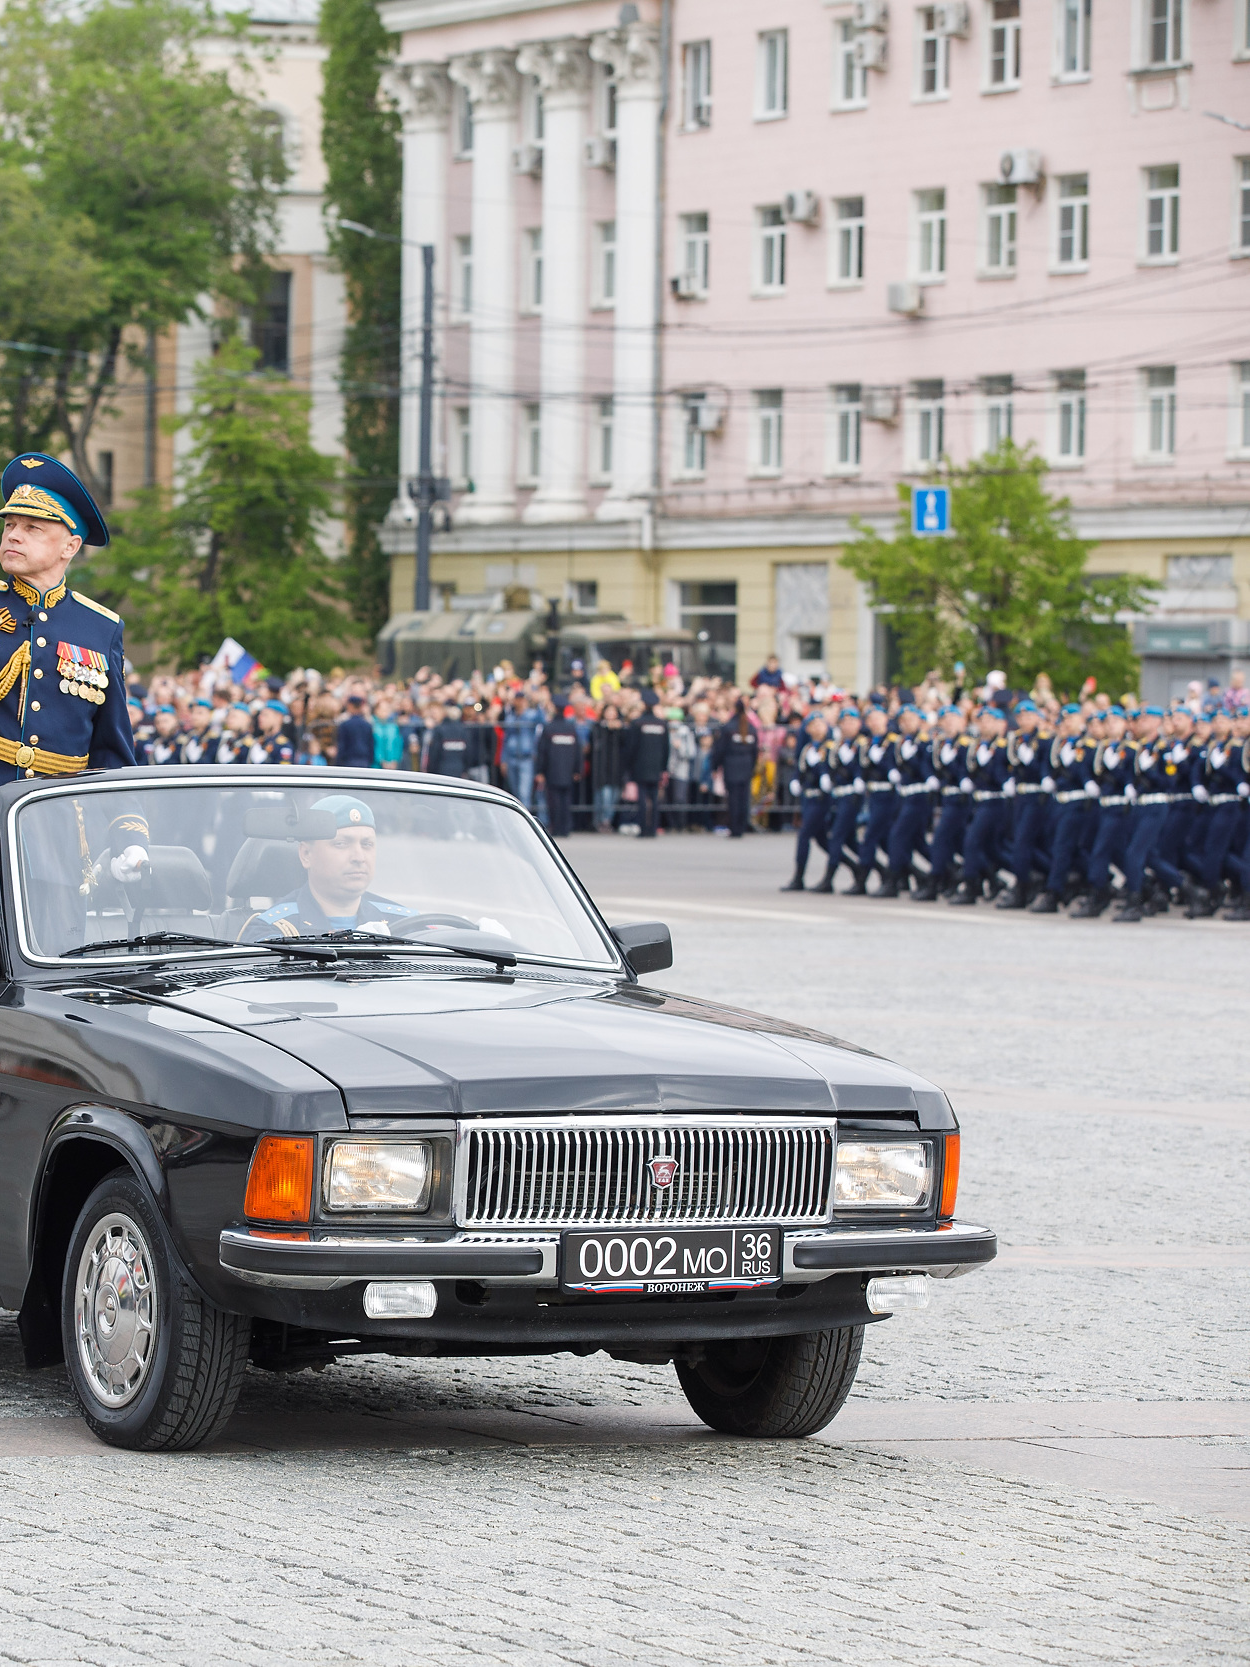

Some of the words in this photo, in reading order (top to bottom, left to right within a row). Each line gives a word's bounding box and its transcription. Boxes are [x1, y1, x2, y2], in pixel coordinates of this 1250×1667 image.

[741, 1233, 772, 1260] 36
[579, 1237, 677, 1278] 0002
[683, 1248, 727, 1275] МО
[741, 1261, 771, 1275] RUS
[646, 1282, 706, 1293] ВОРОНЕЖ
